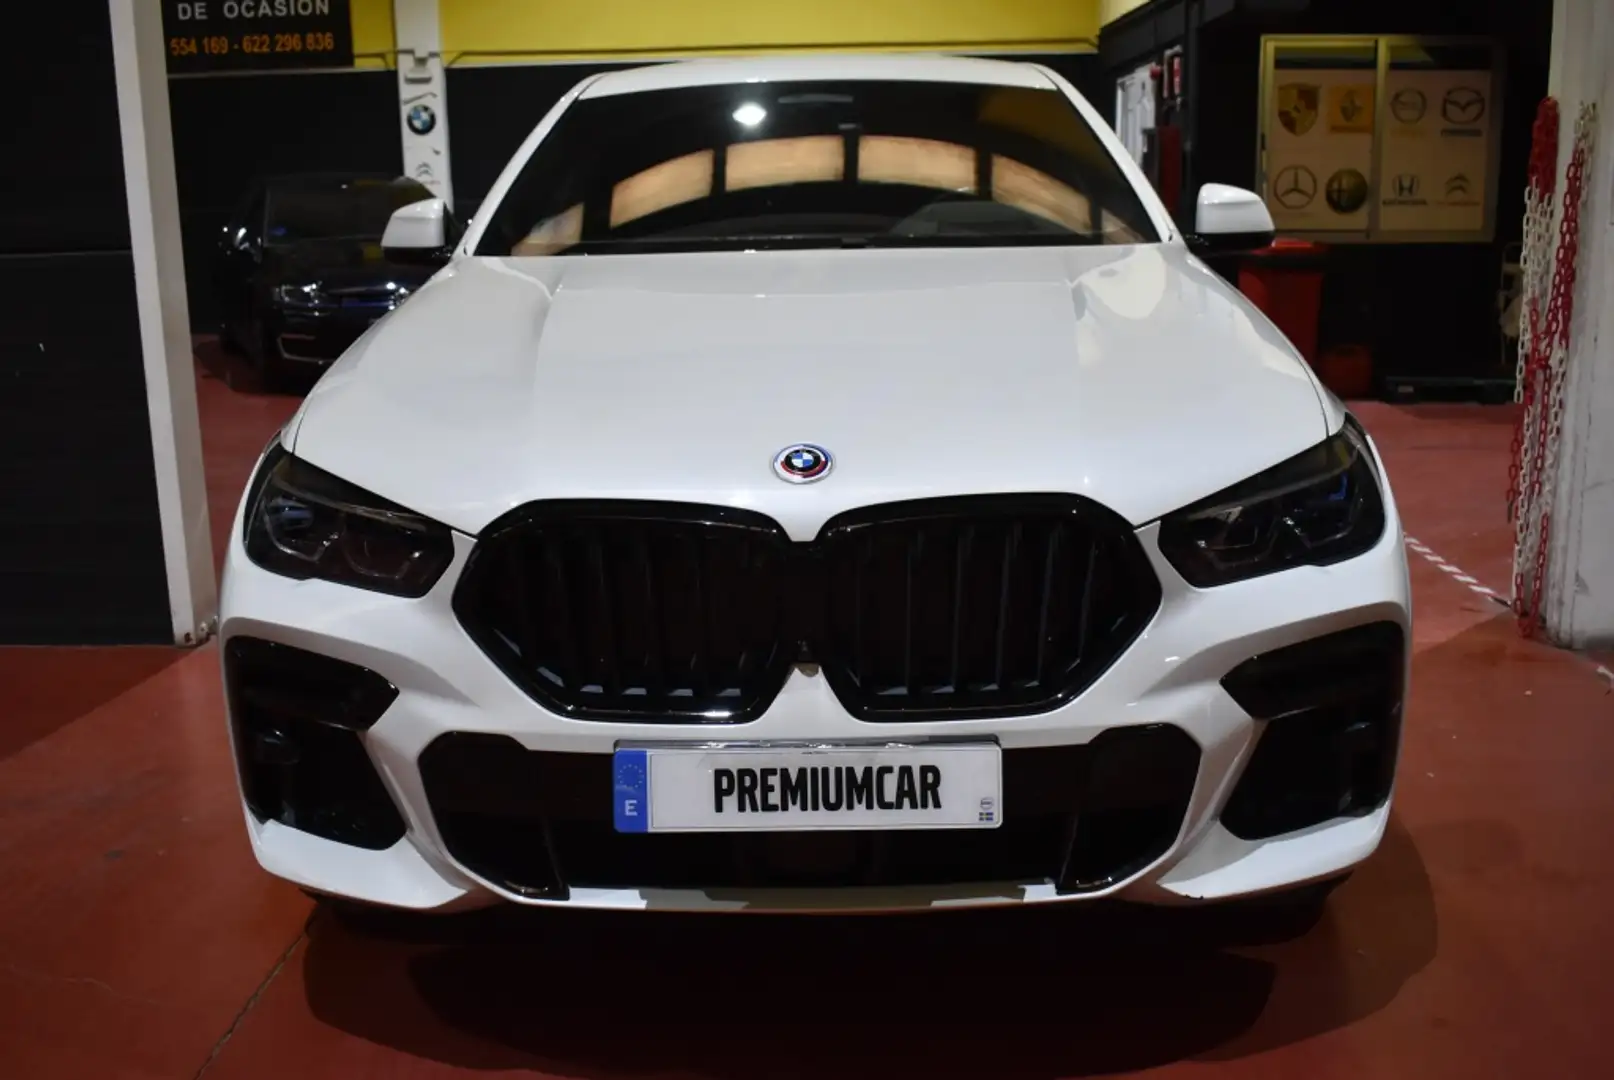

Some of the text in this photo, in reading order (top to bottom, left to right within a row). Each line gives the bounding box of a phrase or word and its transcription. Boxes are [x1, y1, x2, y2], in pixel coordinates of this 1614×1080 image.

[177, 2, 208, 20] DE
[170, 38, 198, 56] 554
[202, 36, 229, 54] 169
[242, 34, 270, 53] 622
[275, 33, 302, 51] 296
[305, 32, 334, 50] 836
[713, 764, 943, 813] PREMIUMCAR
[624, 800, 638, 816] E
